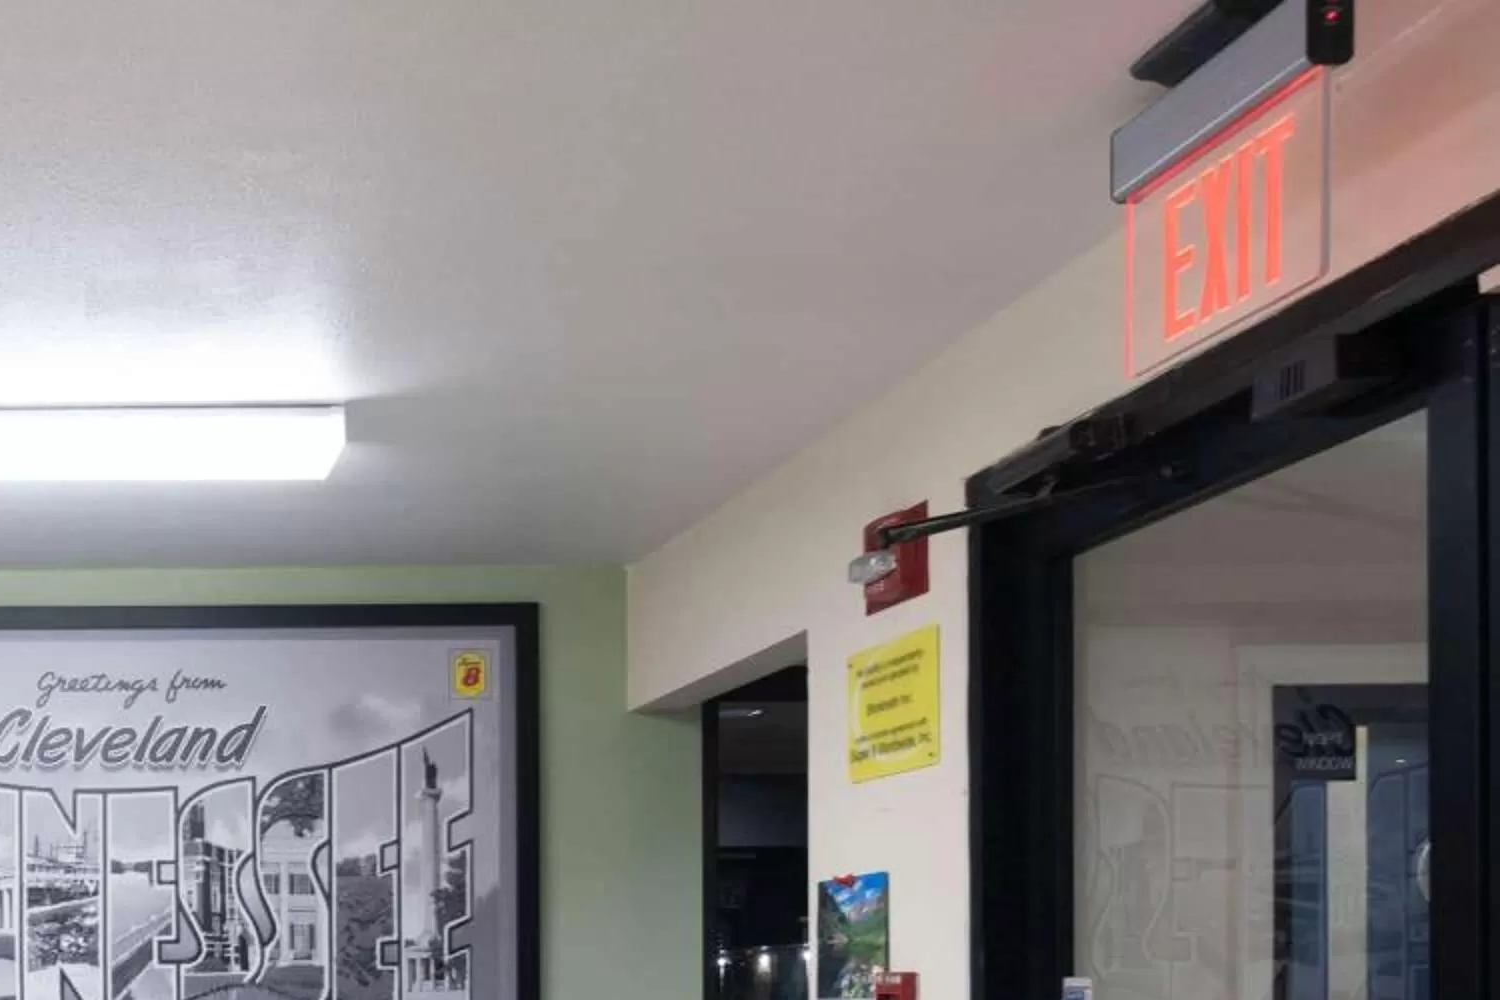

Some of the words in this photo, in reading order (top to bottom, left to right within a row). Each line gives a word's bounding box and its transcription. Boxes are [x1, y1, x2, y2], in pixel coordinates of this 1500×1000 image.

[1164, 112, 1294, 342] EXIT
[36, 671, 158, 709] Greetings
[165, 669, 227, 703] from
